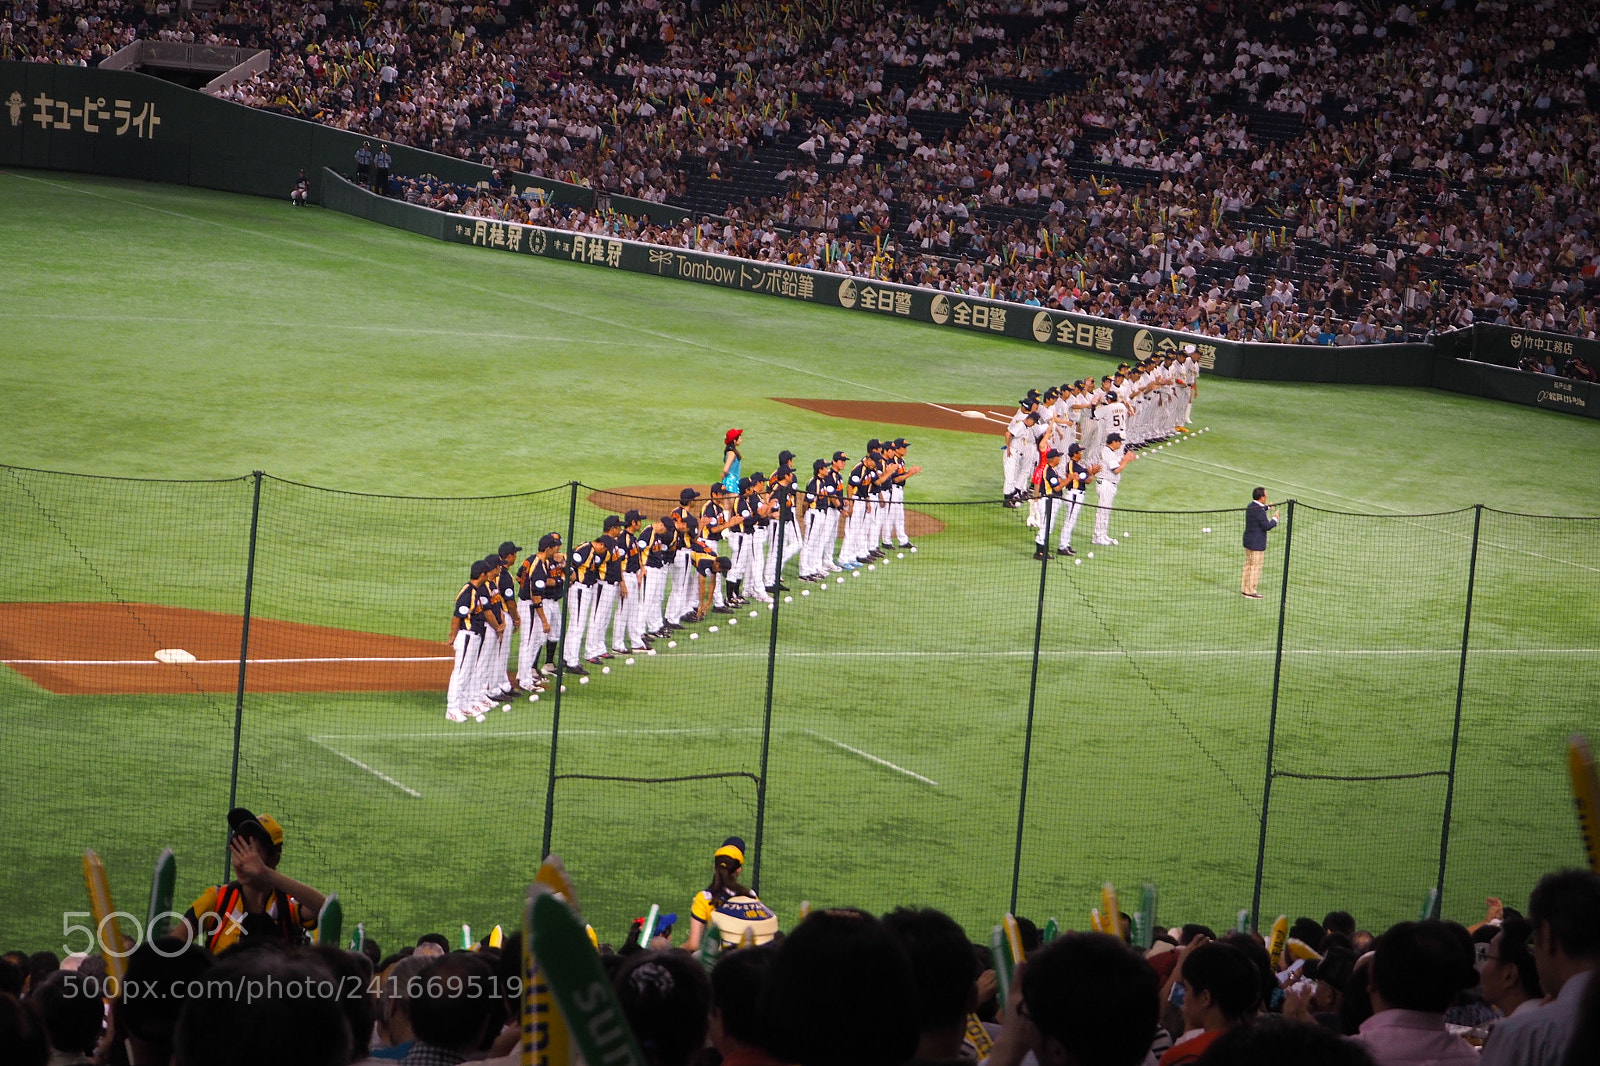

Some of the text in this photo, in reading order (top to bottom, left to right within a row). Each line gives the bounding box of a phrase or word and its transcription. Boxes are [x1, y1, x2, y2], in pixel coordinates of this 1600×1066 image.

[472, 220, 523, 252] 月桂冠
[571, 235, 623, 268] 月桂冠
[676, 254, 814, 299] Tombow トンボ鉛筆
[860, 285, 912, 315] 全日警
[953, 301, 1007, 332] 全日警
[1056, 319, 1114, 351] 全日警
[1524, 335, 1574, 355] 竹中工務店
